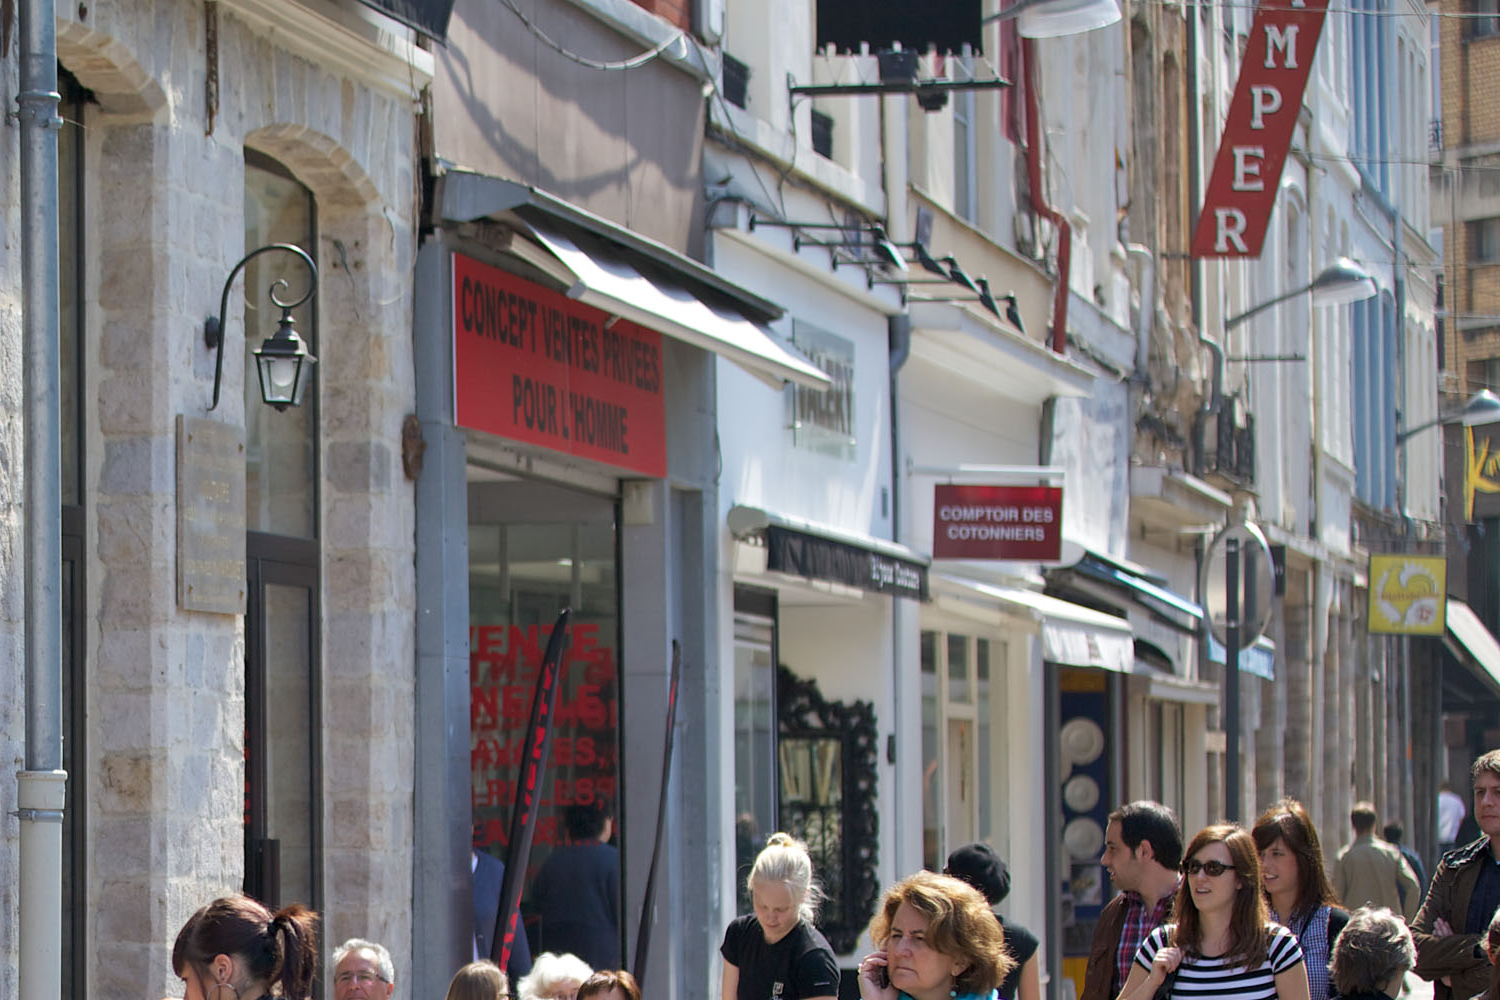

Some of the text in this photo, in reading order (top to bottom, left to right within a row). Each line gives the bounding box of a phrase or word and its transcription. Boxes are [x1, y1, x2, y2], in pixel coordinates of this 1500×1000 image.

[1214, 0, 1306, 253] MPER
[462, 275, 537, 353] CONCEPT
[542, 305, 599, 374] VENTES
[512, 373, 628, 454] POUR L'HOMME
[940, 505, 1053, 523] COMPTOIR DES
[947, 524, 1045, 542] COTONNIERS
[469, 624, 600, 662] ENE
